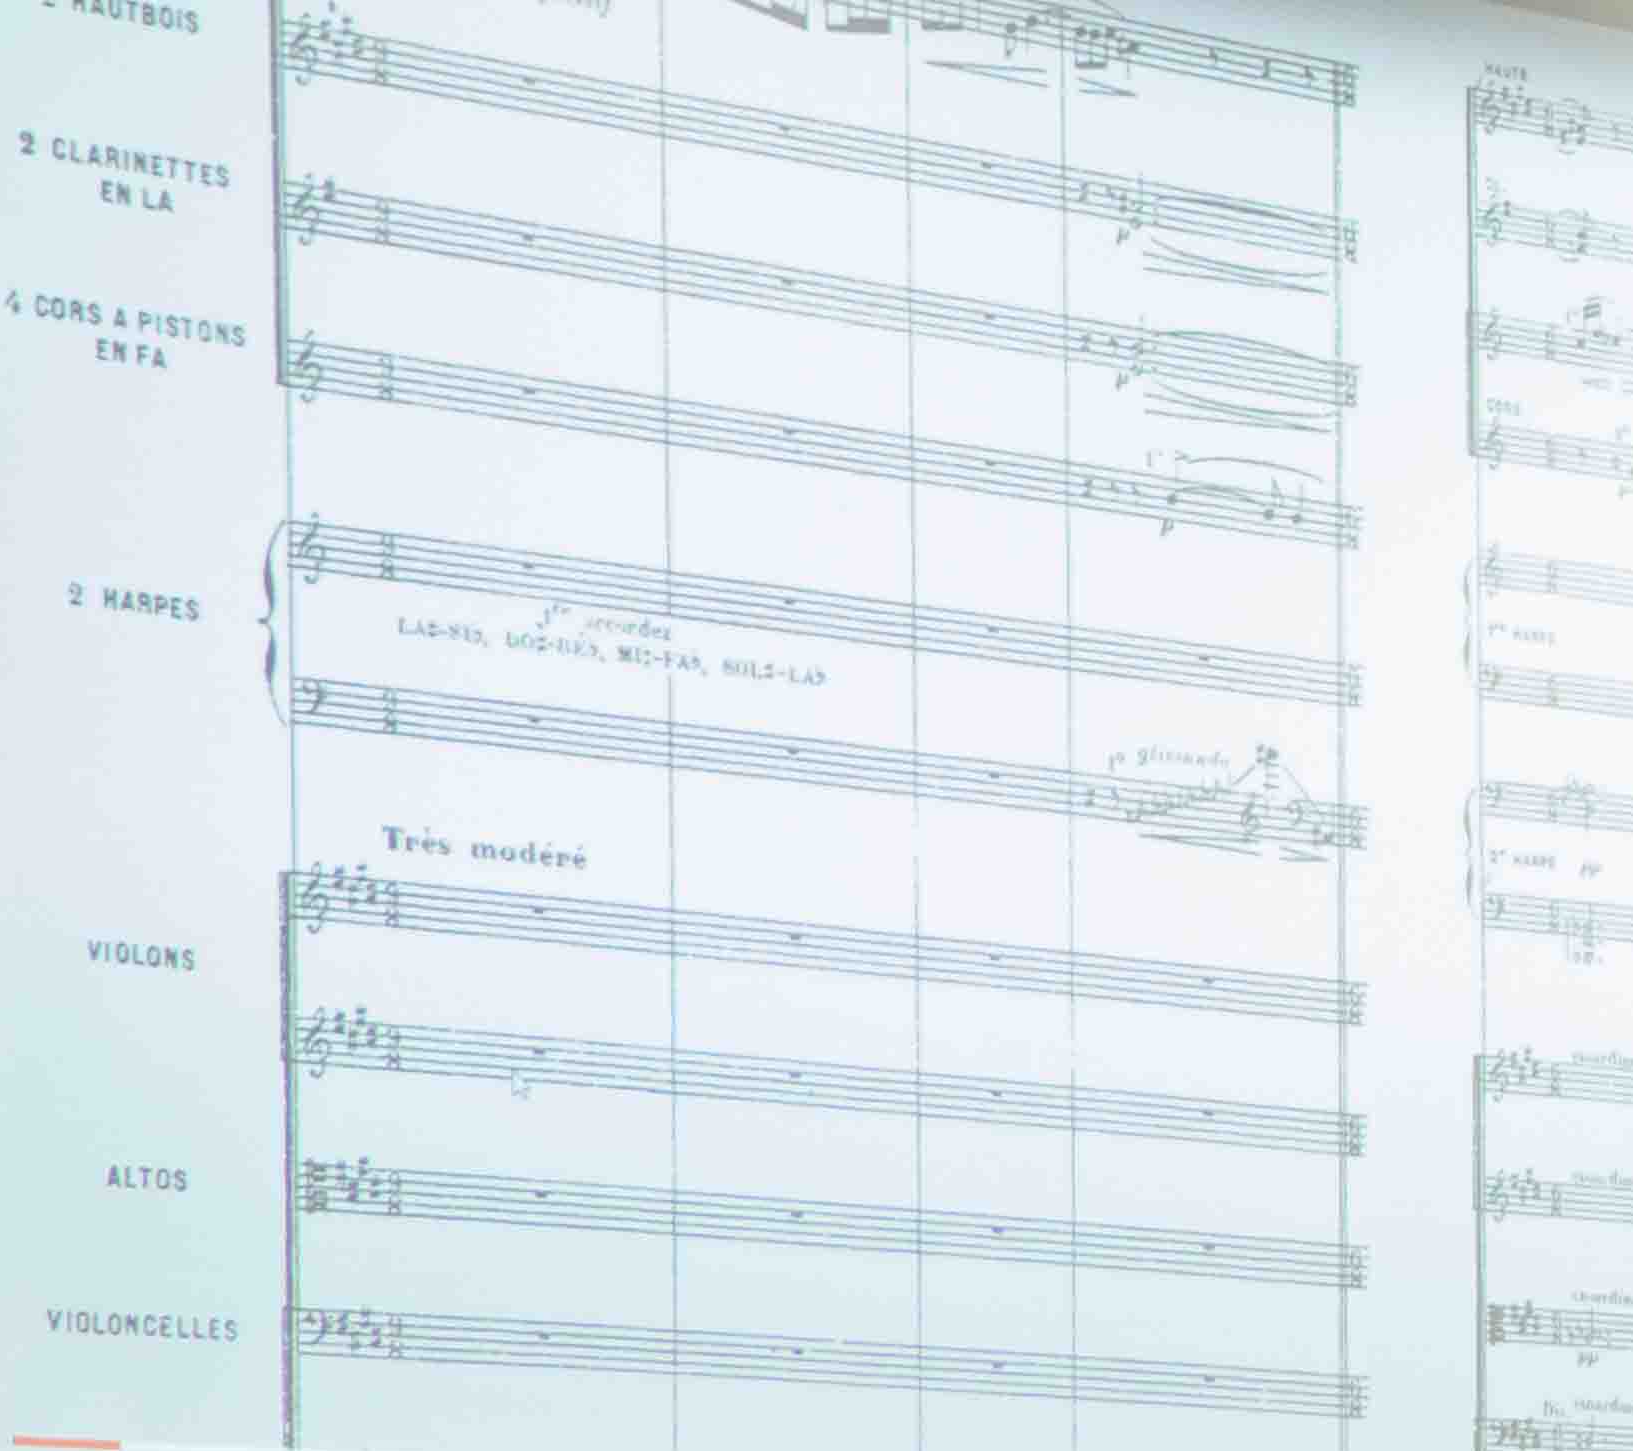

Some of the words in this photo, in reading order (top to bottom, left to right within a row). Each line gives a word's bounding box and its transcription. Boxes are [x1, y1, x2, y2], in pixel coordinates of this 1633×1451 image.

[18, 130, 37, 156] 2
[51, 138, 231, 188] CLARINETTES
[100, 179, 132, 206] EN
[142, 187, 175, 213] LA
[4, 290, 22, 315] 4
[34, 294, 103, 326] CORS
[112, 306, 129, 329] A
[138, 311, 247, 348] PISTONS
[95, 337, 128, 364] EN
[135, 343, 169, 370] FA
[67, 581, 84, 607] 2
[103, 586, 200, 622] HARPES
[470, 838, 589, 870] modéré
[86, 939, 198, 972] VIOLONS
[106, 1164, 188, 1192] ALTOS
[47, 1308, 240, 1343] VIOLONCELLES
